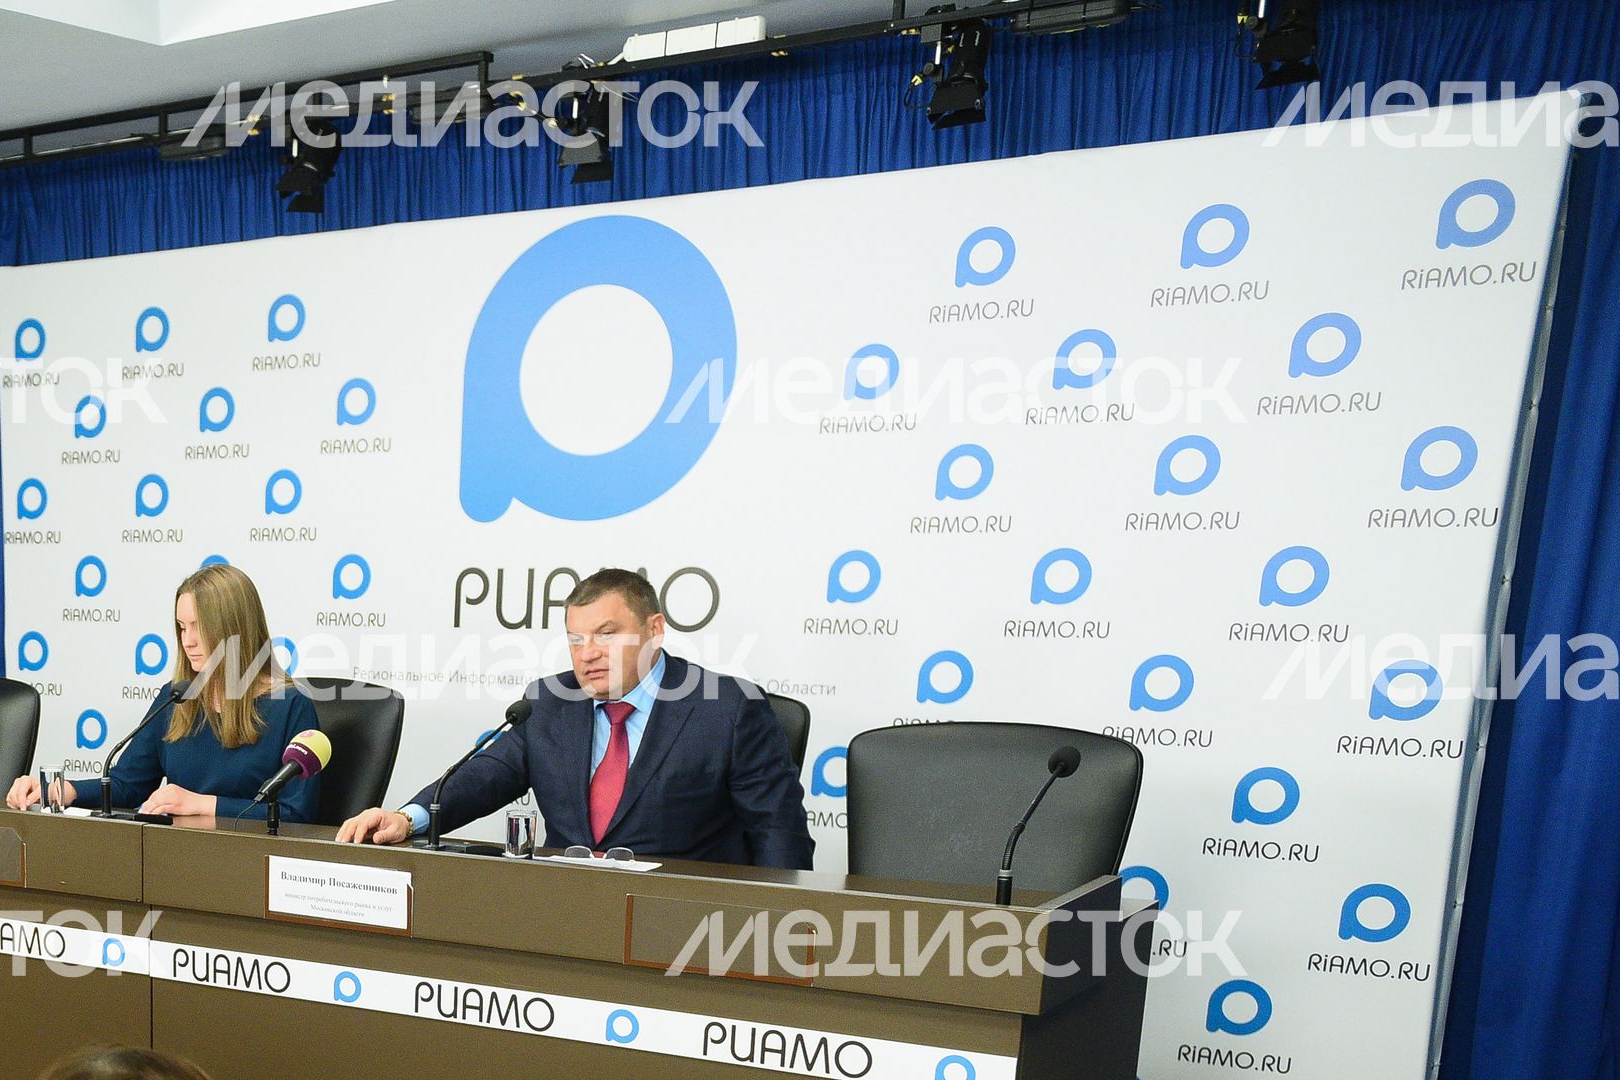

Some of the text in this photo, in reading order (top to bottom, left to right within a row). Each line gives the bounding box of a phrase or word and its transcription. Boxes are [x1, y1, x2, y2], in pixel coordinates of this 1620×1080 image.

[453, 566, 720, 633] РИАО
[766, 679, 836, 696] Области
[280, 871, 326, 888] Владимир
